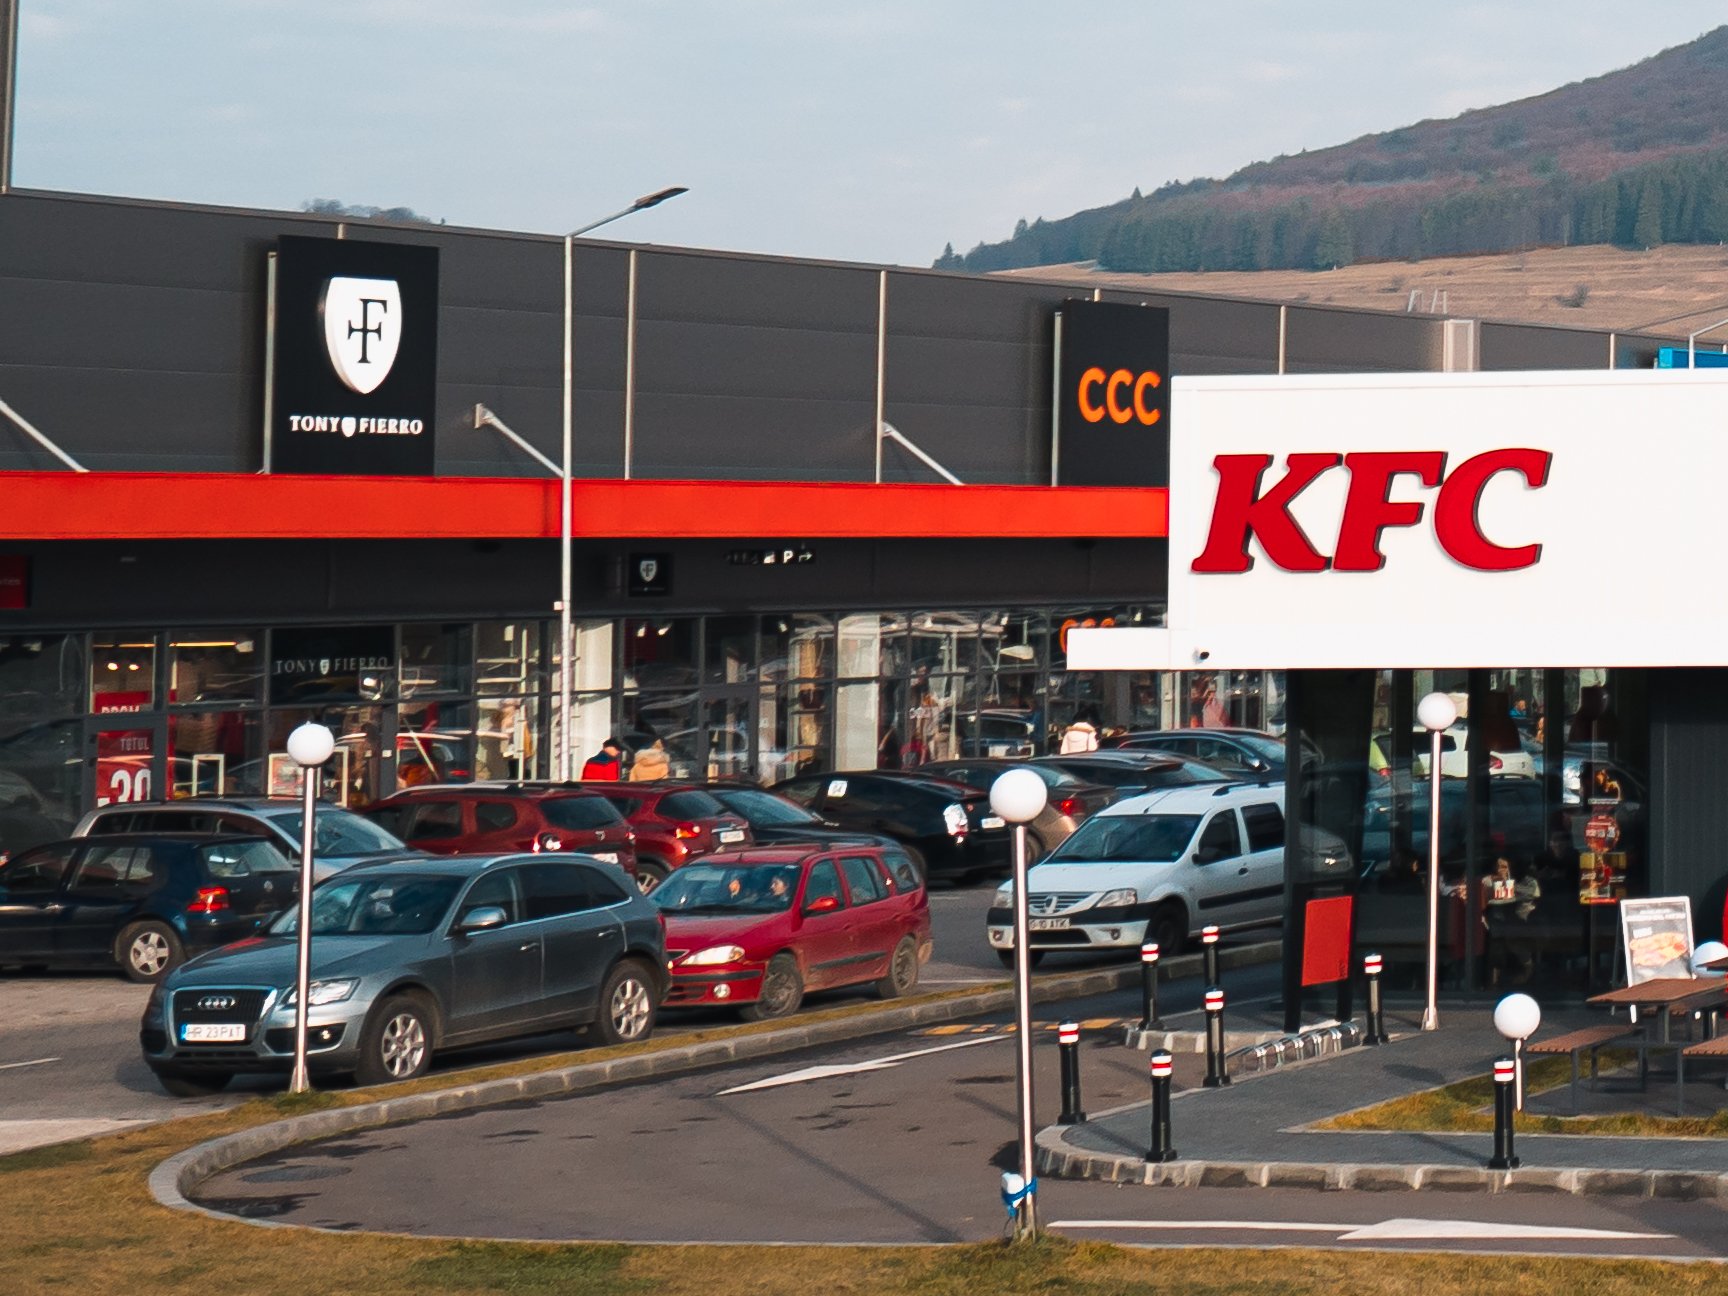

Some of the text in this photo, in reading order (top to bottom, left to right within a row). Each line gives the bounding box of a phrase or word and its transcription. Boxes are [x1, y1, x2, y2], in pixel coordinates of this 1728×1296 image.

[1078, 367, 1161, 426] CCC
[290, 415, 424, 435] TONY FIERRO
[1191, 448, 1553, 574] KFC
[276, 659, 317, 673] TONY
